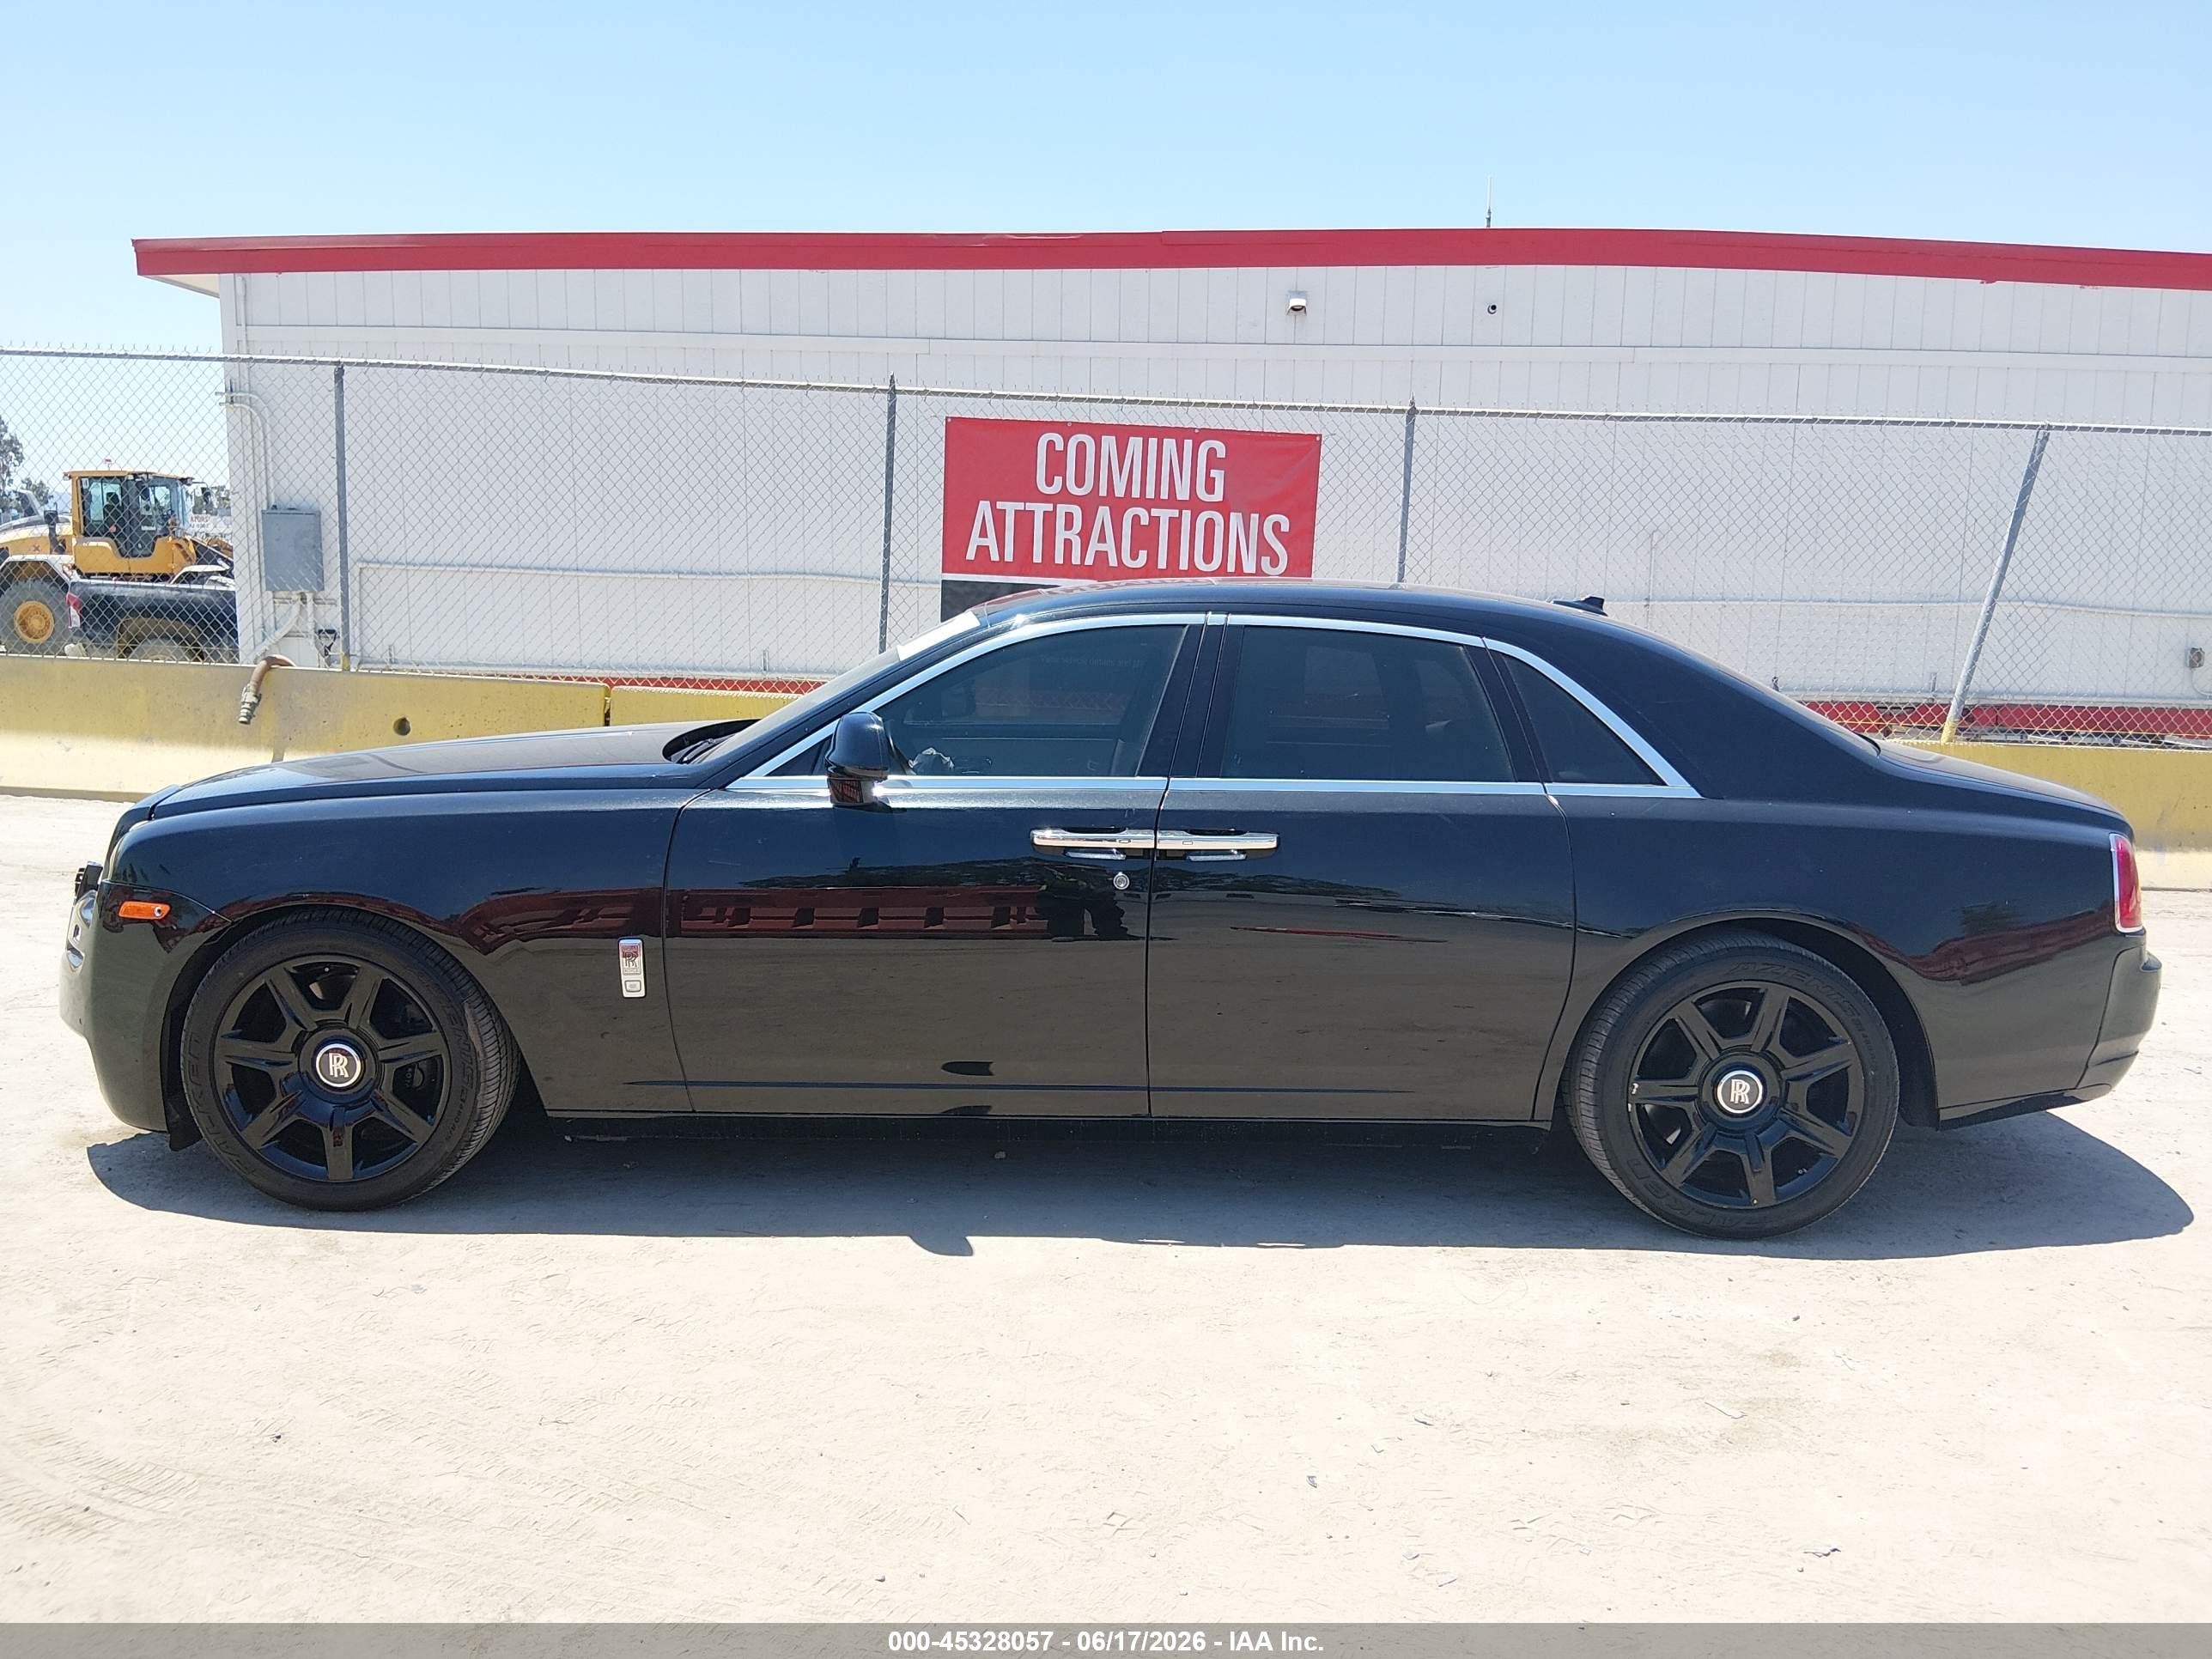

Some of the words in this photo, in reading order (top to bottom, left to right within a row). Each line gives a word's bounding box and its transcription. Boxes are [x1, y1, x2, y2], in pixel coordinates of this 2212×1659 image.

[1036, 432, 1227, 502] COMING
[965, 500, 1291, 576] ATTRACTIONS
[329, 1052, 349, 1078] RR
[1729, 1079, 1751, 1104] RR
